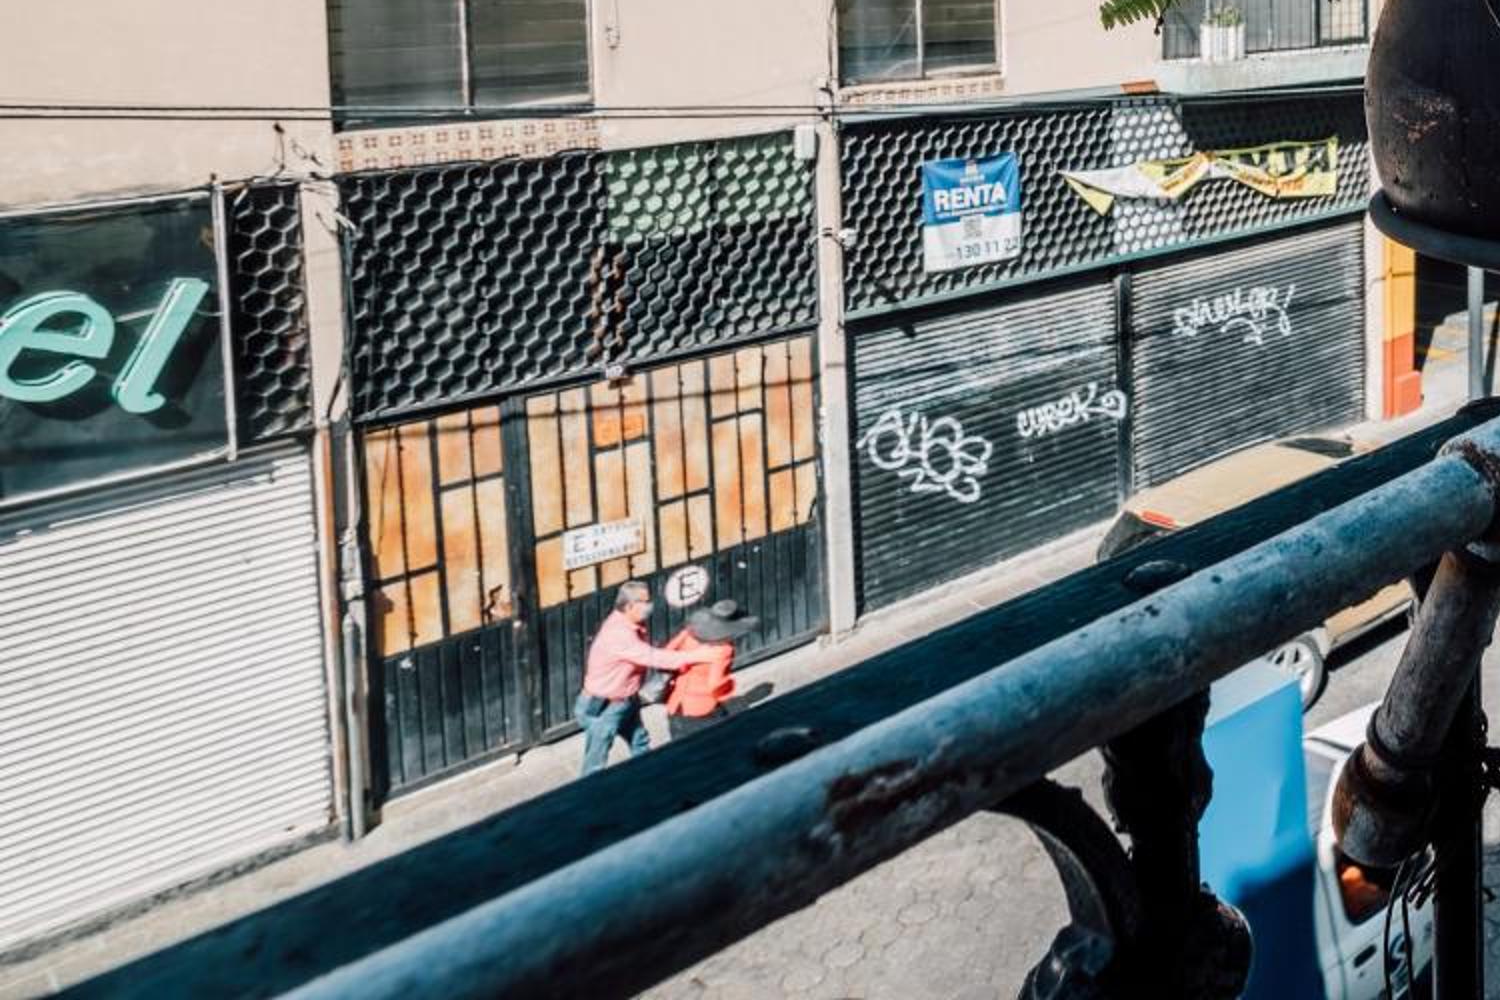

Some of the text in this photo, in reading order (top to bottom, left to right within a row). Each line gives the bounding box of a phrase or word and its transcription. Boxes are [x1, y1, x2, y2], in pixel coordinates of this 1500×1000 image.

[933, 181, 1008, 213] RENTA
[0, 276, 210, 414] el
[679, 571, 701, 600] E
